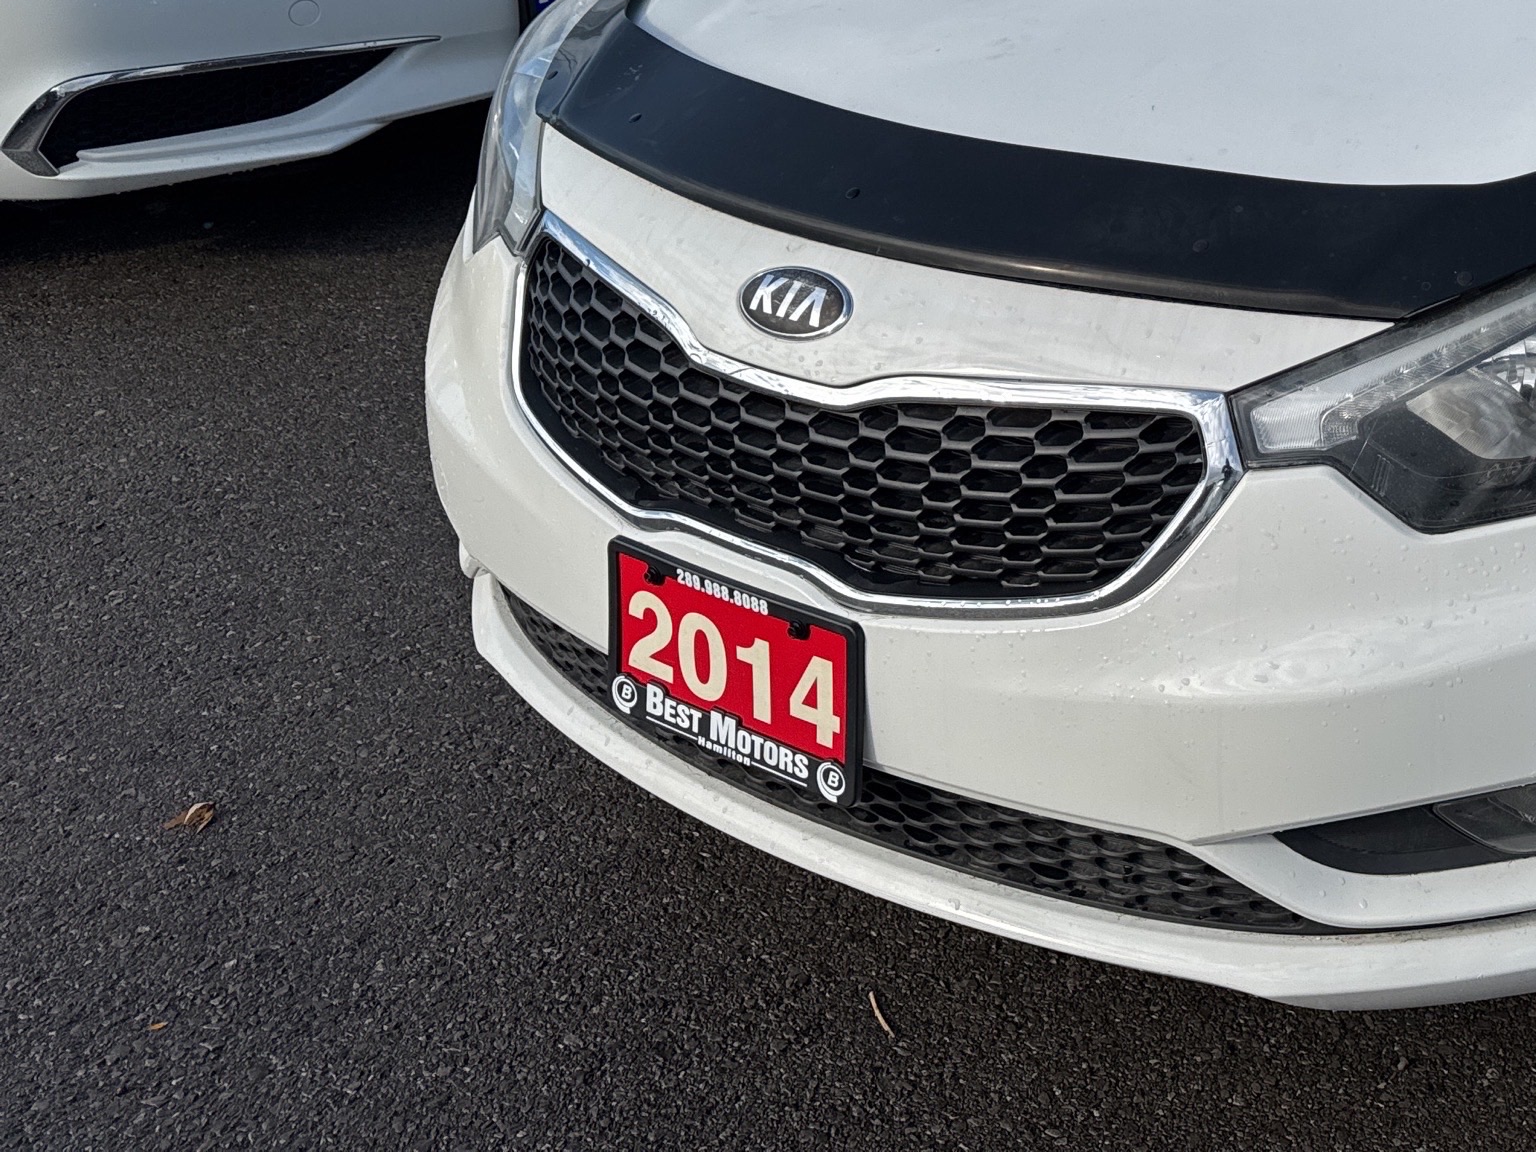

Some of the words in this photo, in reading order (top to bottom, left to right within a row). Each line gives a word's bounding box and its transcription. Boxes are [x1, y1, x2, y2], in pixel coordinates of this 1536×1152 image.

[749, 274, 827, 328] KIA
[676, 568, 769, 616] 289.988.8088
[628, 590, 840, 749] 2014
[646, 683, 702, 733] BEST
[710, 711, 808, 779] MOTORS
[697, 736, 752, 767] Hamilton
